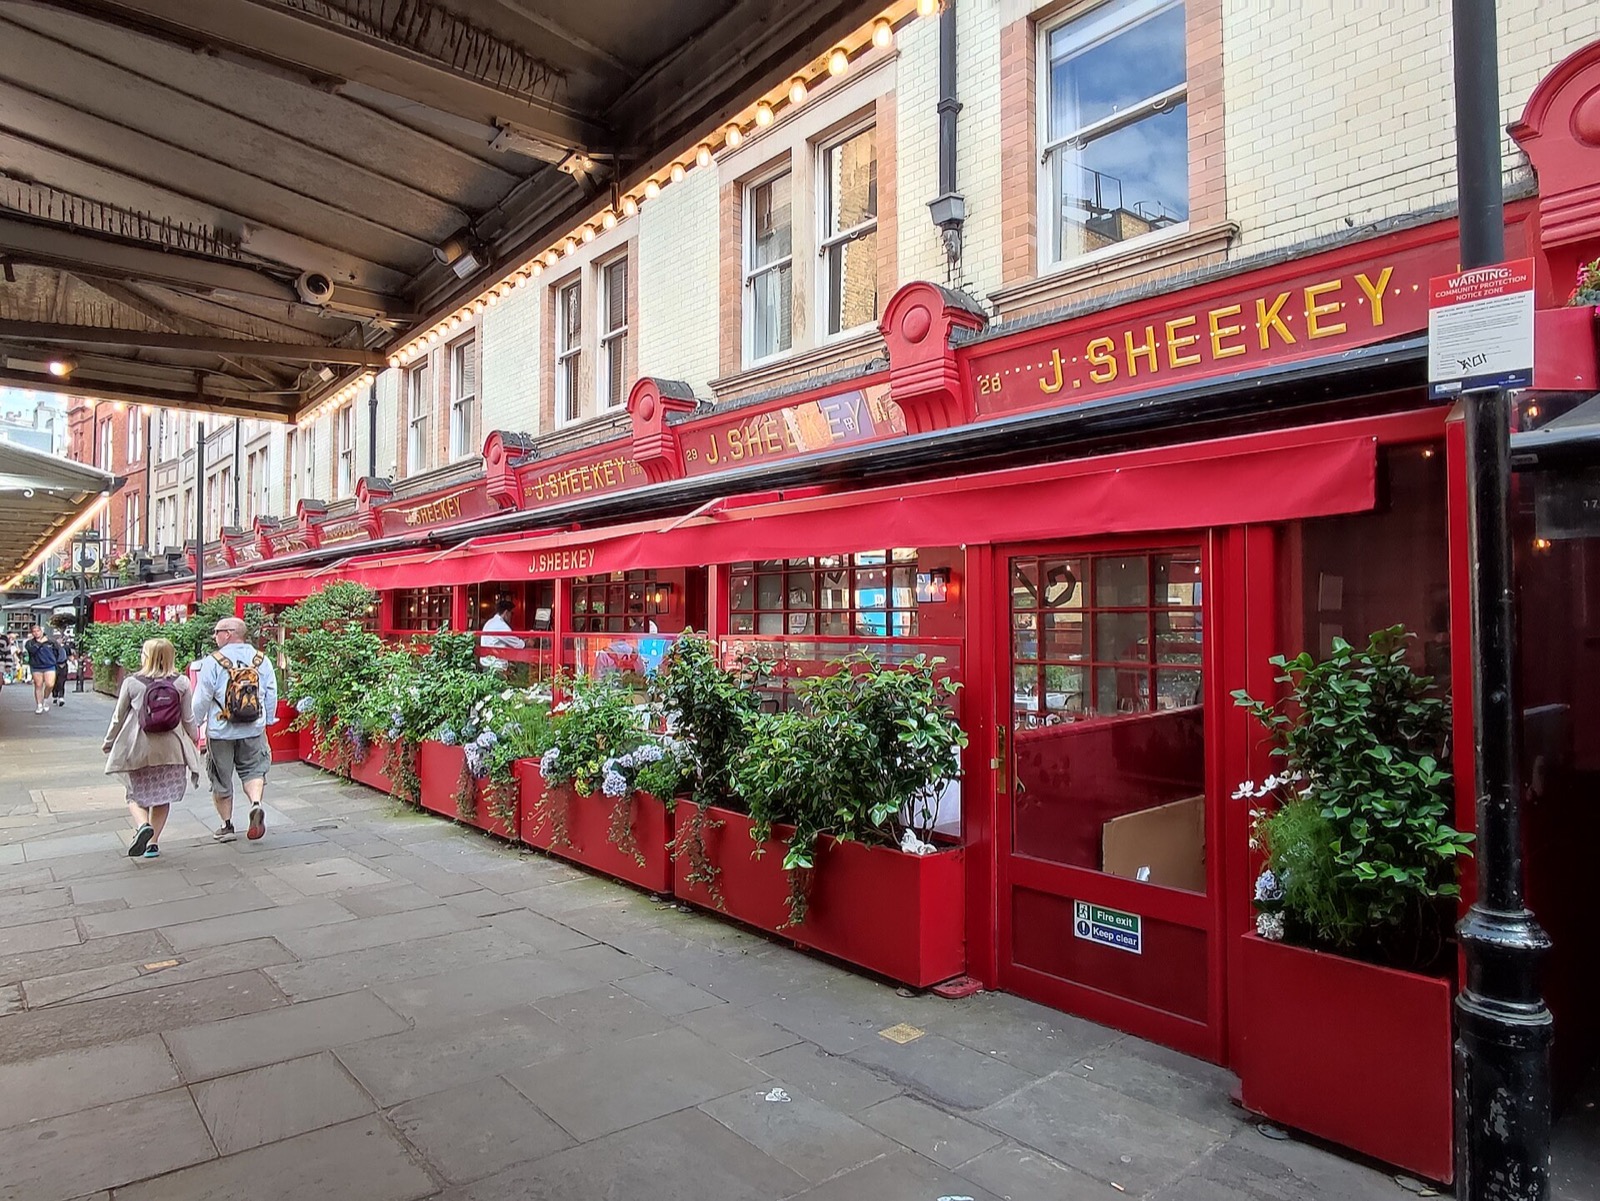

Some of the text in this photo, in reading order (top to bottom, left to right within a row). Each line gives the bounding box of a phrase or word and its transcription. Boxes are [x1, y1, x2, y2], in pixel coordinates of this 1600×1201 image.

[1435, 275, 1527, 298] COMMUNITY PROTECTION
[1448, 269, 1512, 288] WARNING:
[1456, 287, 1504, 301] NOTICE ZONE
[980, 377, 1002, 395] 28
[686, 448, 698, 461] 29
[528, 548, 596, 573] J.SHEEKEY
[1097, 911, 1133, 928] Fire exit
[1093, 926, 1137, 946] Keep clear
